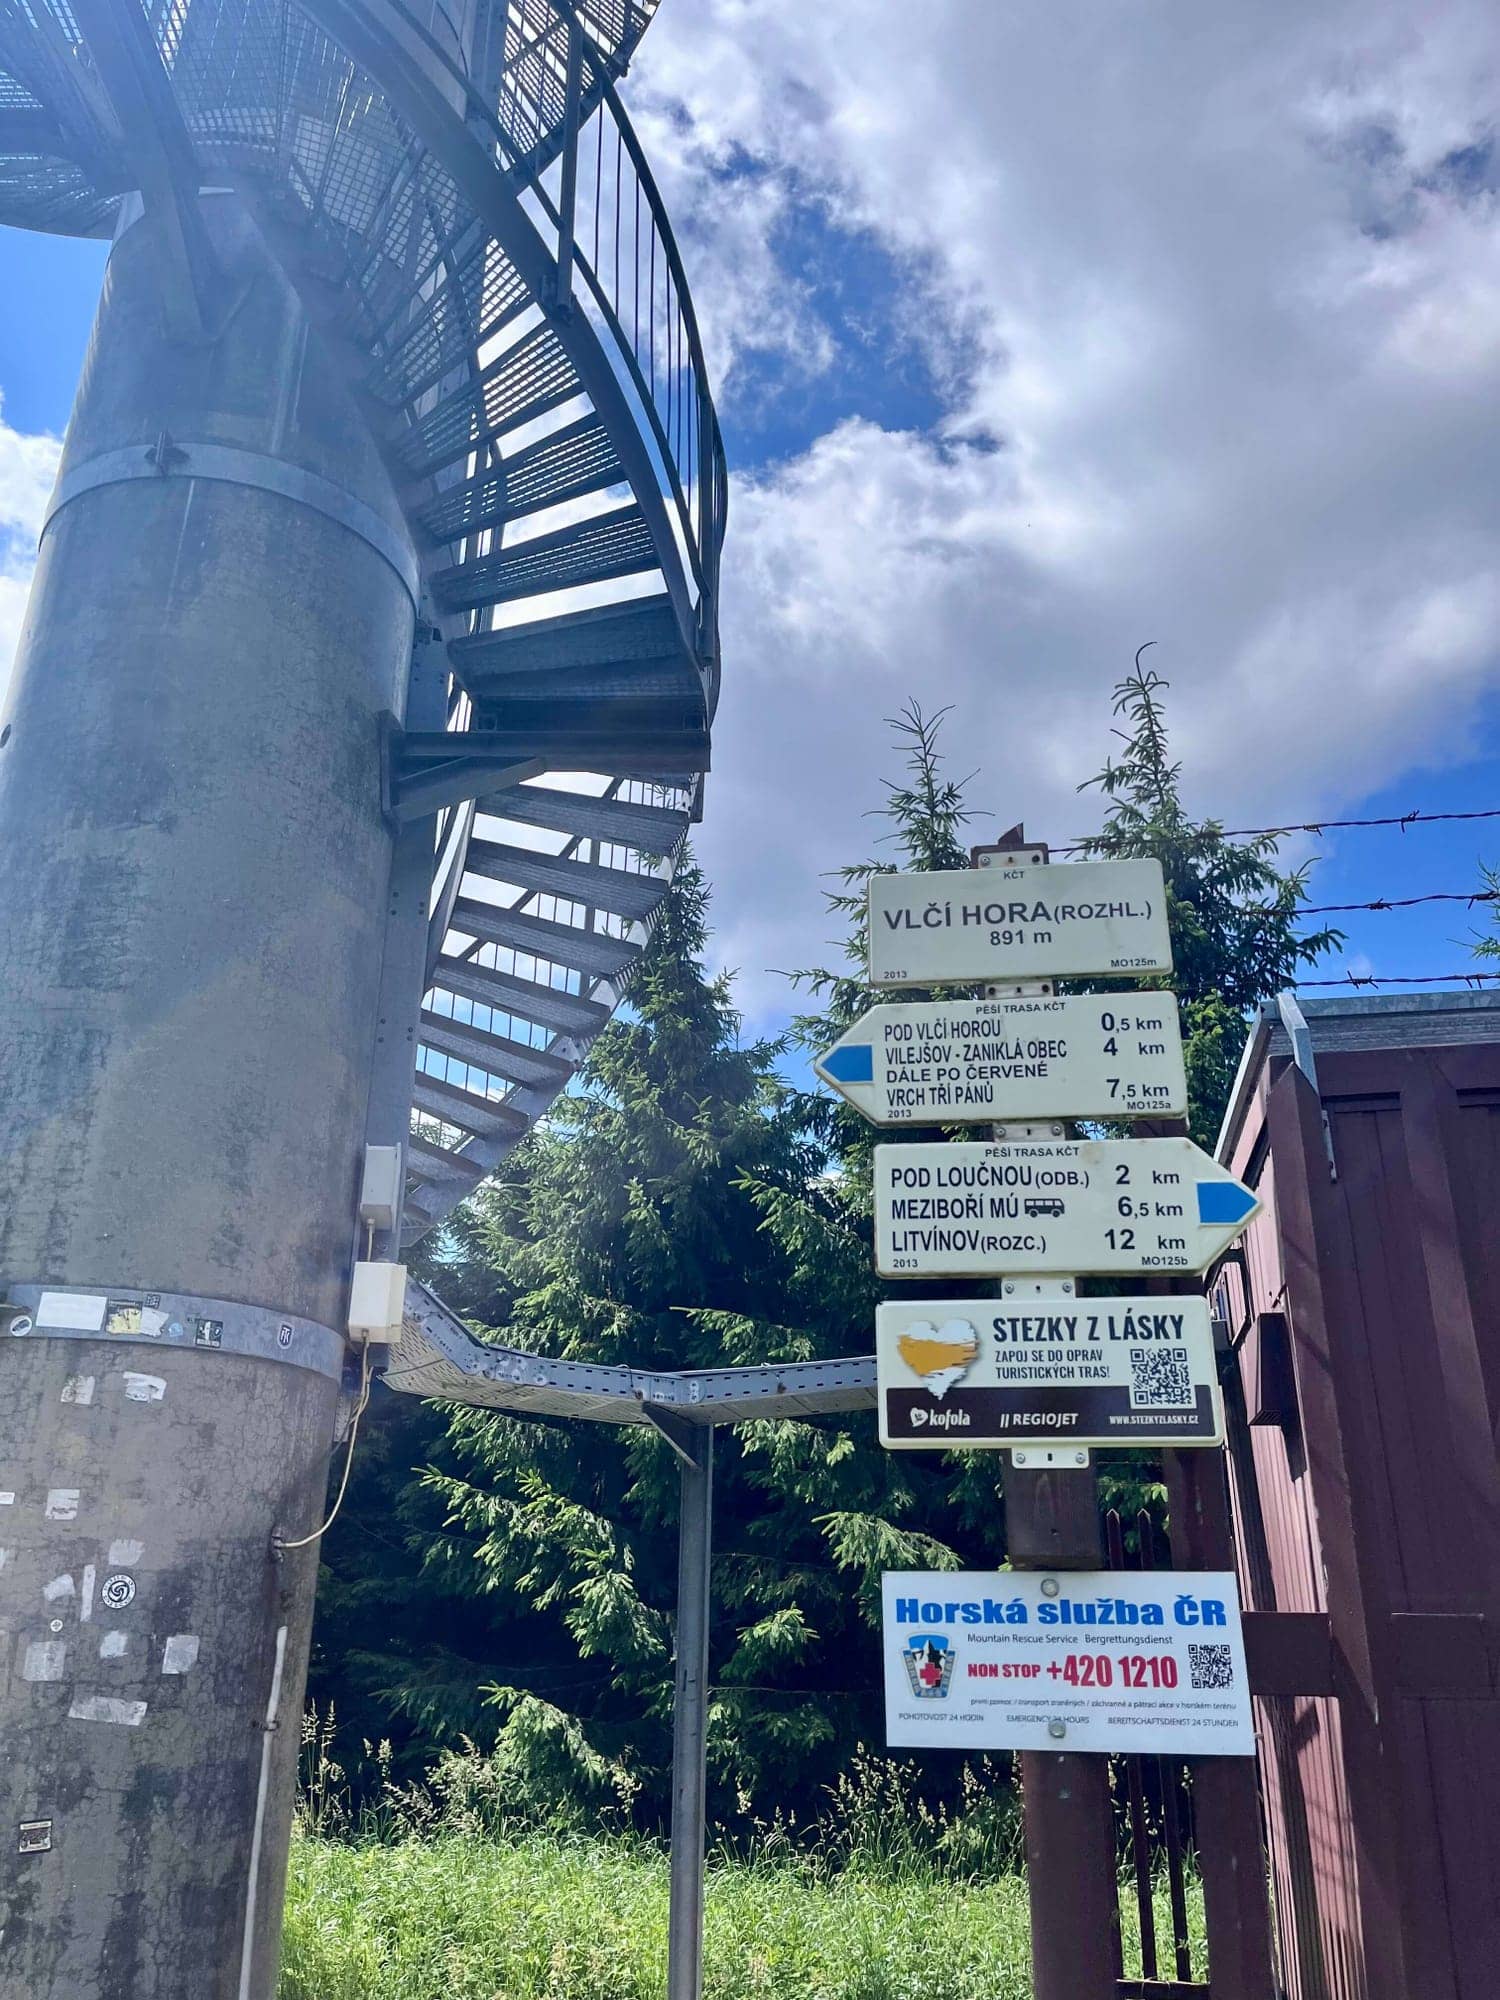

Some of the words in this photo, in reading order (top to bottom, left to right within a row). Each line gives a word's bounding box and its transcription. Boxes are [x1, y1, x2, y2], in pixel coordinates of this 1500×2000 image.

[1003, 870, 1025, 881] KČT
[883, 902, 952, 930] VLČÍ
[962, 901, 1051, 926] HORA
[990, 930, 1024, 946] 891
[1033, 931, 1052, 944] m
[1110, 957, 1157, 968] MO125m
[883, 971, 908, 979] 2013
[975, 1004, 1001, 1015] PĚŠÍ
[1004, 1003, 1042, 1014] TRASA
[1043, 1001, 1067, 1013] KČT
[884, 1023, 913, 1042] POD
[916, 1018, 947, 1040] VLČÍ
[951, 1019, 1001, 1039] HOROU
[1101, 1012, 1130, 1033] 0,5
[1136, 1017, 1163, 1031] km
[885, 1041, 952, 1065] VILEJŠOV
[963, 1037, 1024, 1062] ZANIKLÁ
[1027, 1039, 1068, 1060] OBEC
[1103, 1037, 1119, 1057] 4
[1138, 1041, 1165, 1056] km
[886, 1066, 931, 1084] DÁLE
[937, 1067, 960, 1081] PO
[966, 1060, 1049, 1080] ČERVENÉ
[887, 1087, 925, 1107] VRCH
[929, 1082, 951, 1105] TŘÍ
[955, 1080, 994, 1105] PÁNŮ
[1106, 1078, 1137, 1101] 7,5
[1142, 1084, 1170, 1098] km
[888, 1108, 912, 1119] 2013
[1127, 1100, 1172, 1111] MO125a
[985, 1147, 1011, 1159] PĚŠÍ
[1014, 1147, 1054, 1158] TRASA
[1056, 1144, 1080, 1157] KČT
[892, 1167, 931, 1189] POD
[937, 1160, 1032, 1188] LOUČNOU
[1115, 1164, 1131, 1185] 2
[1152, 1170, 1180, 1184] km
[892, 1192, 984, 1220] MEZIBOŘÍ
[990, 1191, 1019, 1219] MÚ
[1118, 1195, 1150, 1219] 6,5
[1155, 1201, 1184, 1216] km
[892, 1224, 980, 1252] LITVÍNOV
[1104, 1228, 1136, 1250] 12
[1157, 1234, 1186, 1250] km
[893, 1258, 918, 1268] 2013
[1141, 1255, 1189, 1266] MO125b
[992, 1316, 1078, 1343] STEZKY
[1087, 1316, 1100, 1341] Z
[1108, 1307, 1184, 1341] LÁSKY
[995, 1350, 1028, 1363] ZAPOJ
[1031, 1349, 1045, 1362] SE
[1048, 1349, 1063, 1362] DO
[1066, 1349, 1103, 1362] OPRAV
[996, 1362, 1075, 1380] TURISTICKÝCH
[1078, 1365, 1111, 1379] TRAS!
[929, 1408, 971, 1431] kofola
[1012, 1412, 1079, 1428] REGIOJET
[896, 1597, 1028, 1624] Horská
[1038, 1597, 1165, 1626] služba
[1174, 1594, 1228, 1627] ČR
[967, 1634, 1010, 1644] Mountain
[1012, 1634, 1043, 1644] Rescue
[1046, 1635, 1079, 1644] Service
[1085, 1634, 1173, 1646] Bergrettungsdienst
[967, 1663, 999, 1678] NON
[1002, 1664, 1041, 1678] STOP
[1046, 1655, 1113, 1687] +420
[1118, 1656, 1179, 1689] 1210
